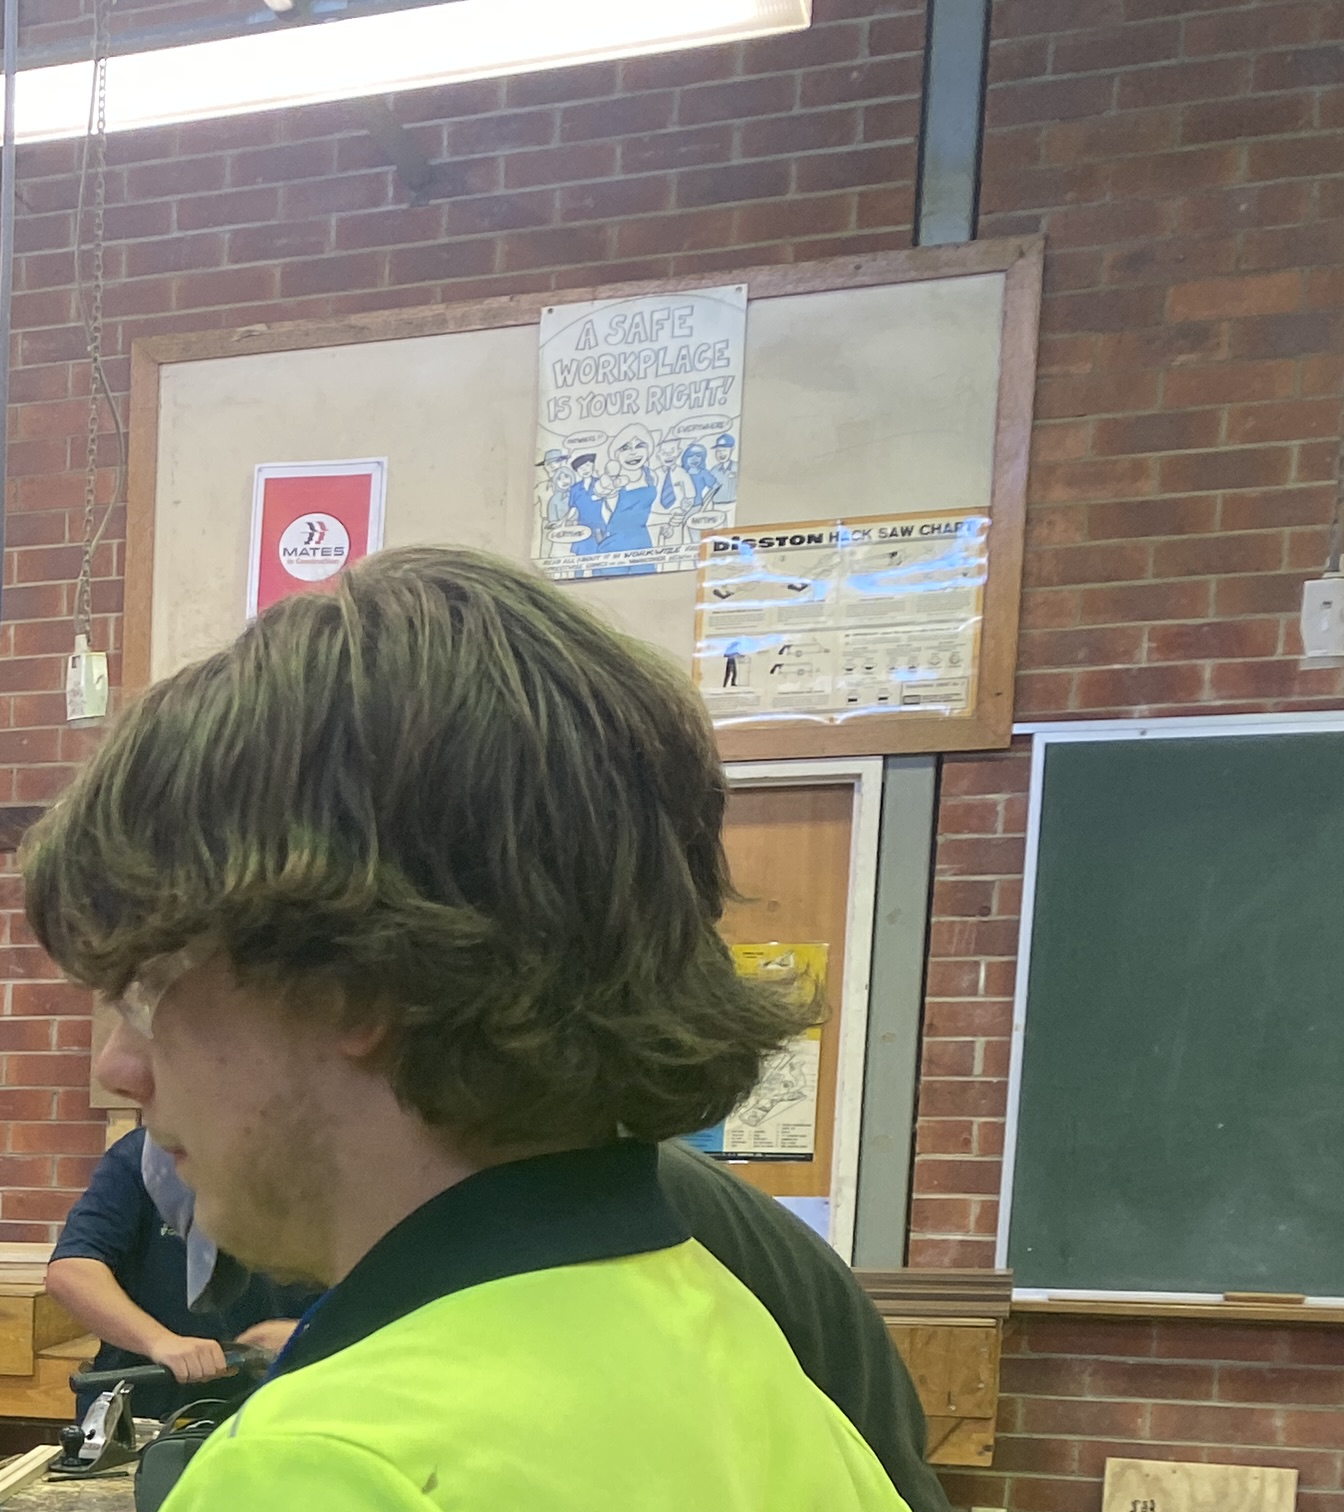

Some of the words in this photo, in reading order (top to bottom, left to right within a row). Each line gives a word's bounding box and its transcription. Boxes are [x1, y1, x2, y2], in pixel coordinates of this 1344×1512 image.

[575, 319, 598, 351] A
[604, 305, 694, 346] SAFE
[552, 338, 730, 389] WORKPLACE
[547, 396, 572, 423] IS
[576, 391, 640, 420] YOUR
[645, 375, 736, 415] RIGHT!
[282, 546, 345, 557] MATES
[878, 525, 914, 539] SAW
